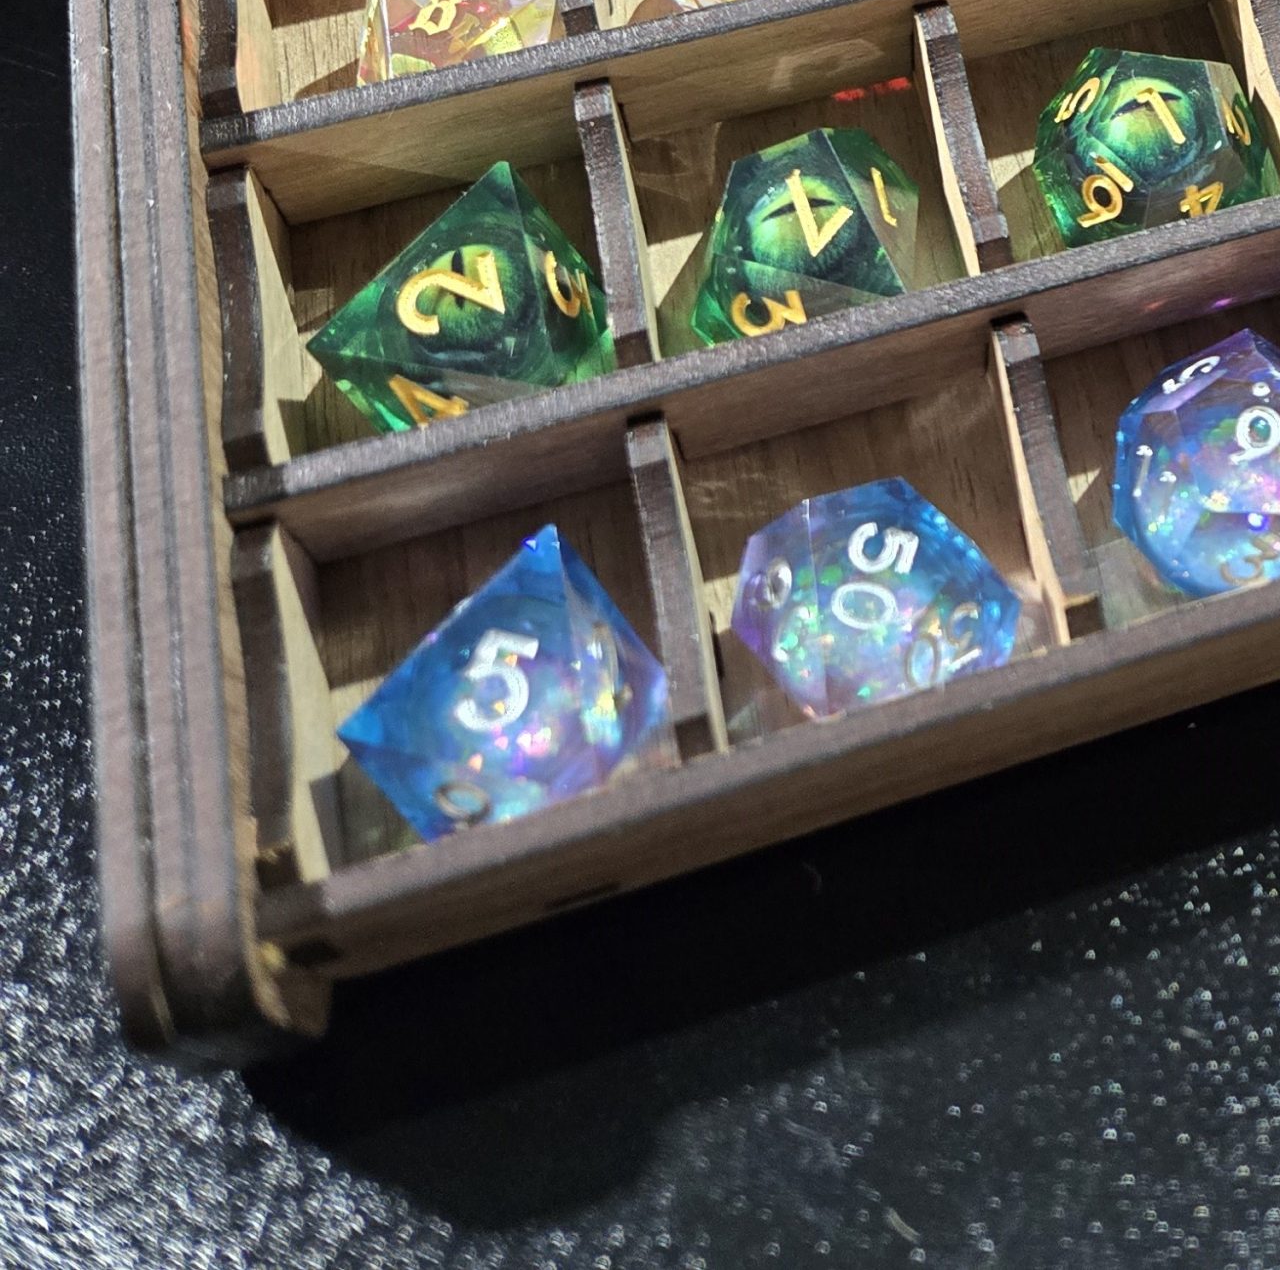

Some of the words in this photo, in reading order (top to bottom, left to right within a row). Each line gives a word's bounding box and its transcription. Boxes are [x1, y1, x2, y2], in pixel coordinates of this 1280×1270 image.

[396, 250, 506, 336] 2
[829, 521, 920, 631] 50
[454, 626, 540, 732] 5
